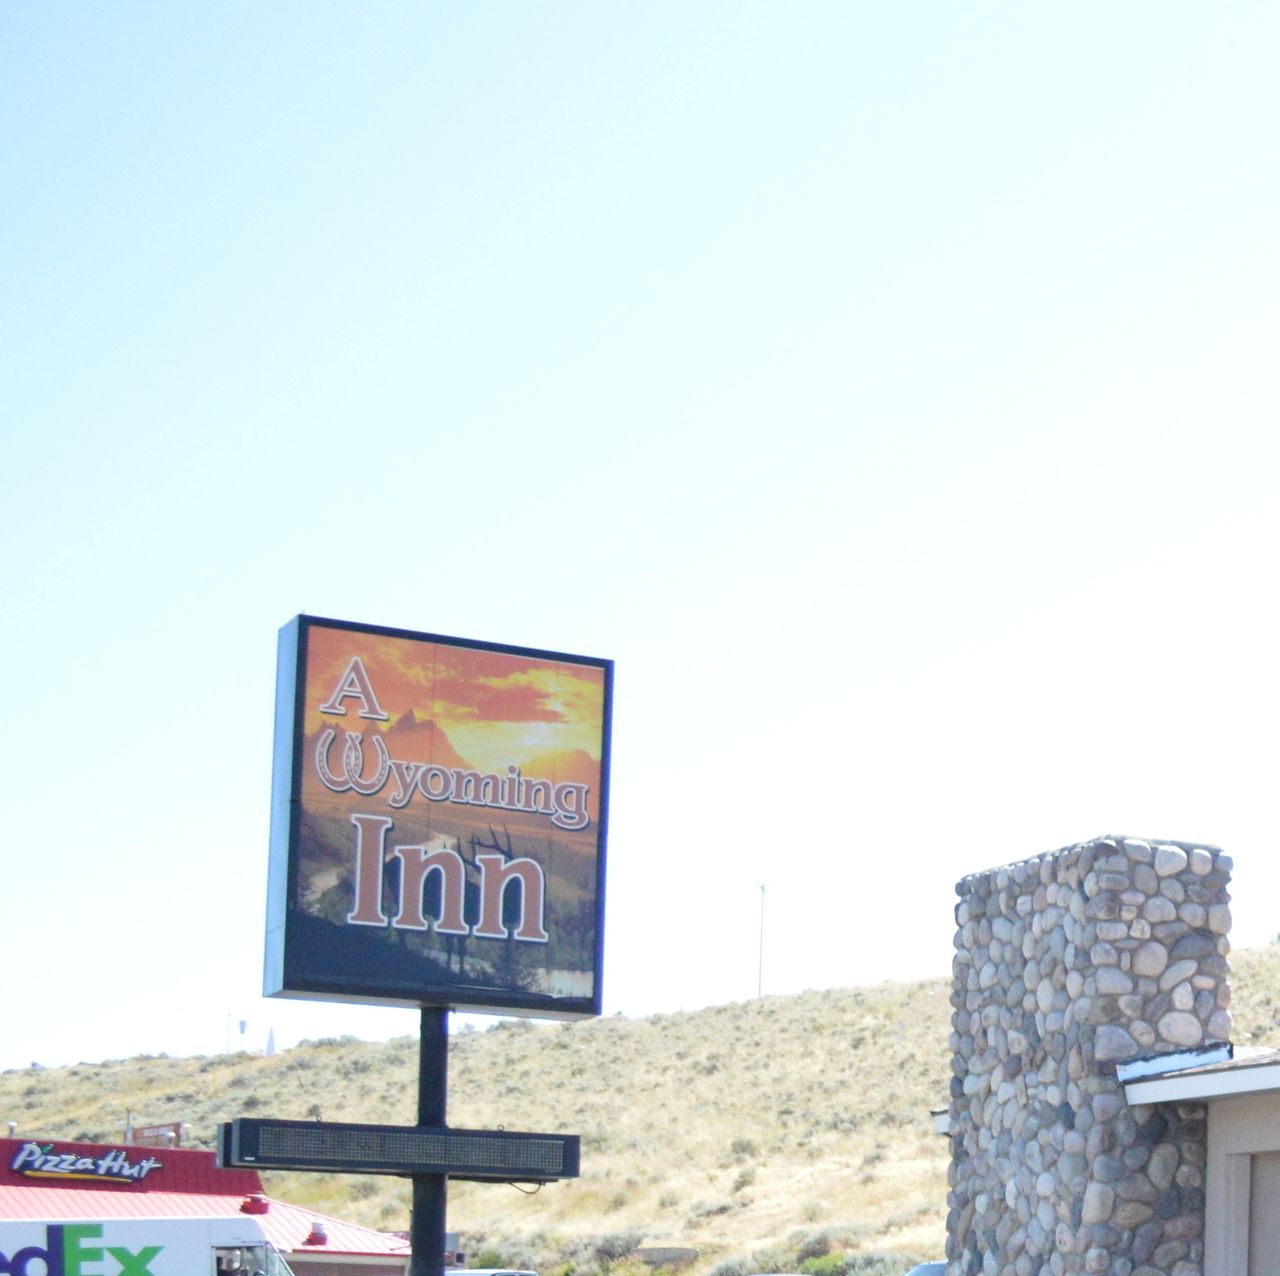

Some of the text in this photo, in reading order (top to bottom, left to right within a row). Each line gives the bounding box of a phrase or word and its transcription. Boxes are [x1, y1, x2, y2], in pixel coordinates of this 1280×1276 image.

[319, 656, 389, 720] A
[316, 729, 590, 830] Wyoming
[347, 813, 548, 943] Inn
[12, 1142, 163, 1179] Pizza Hut
